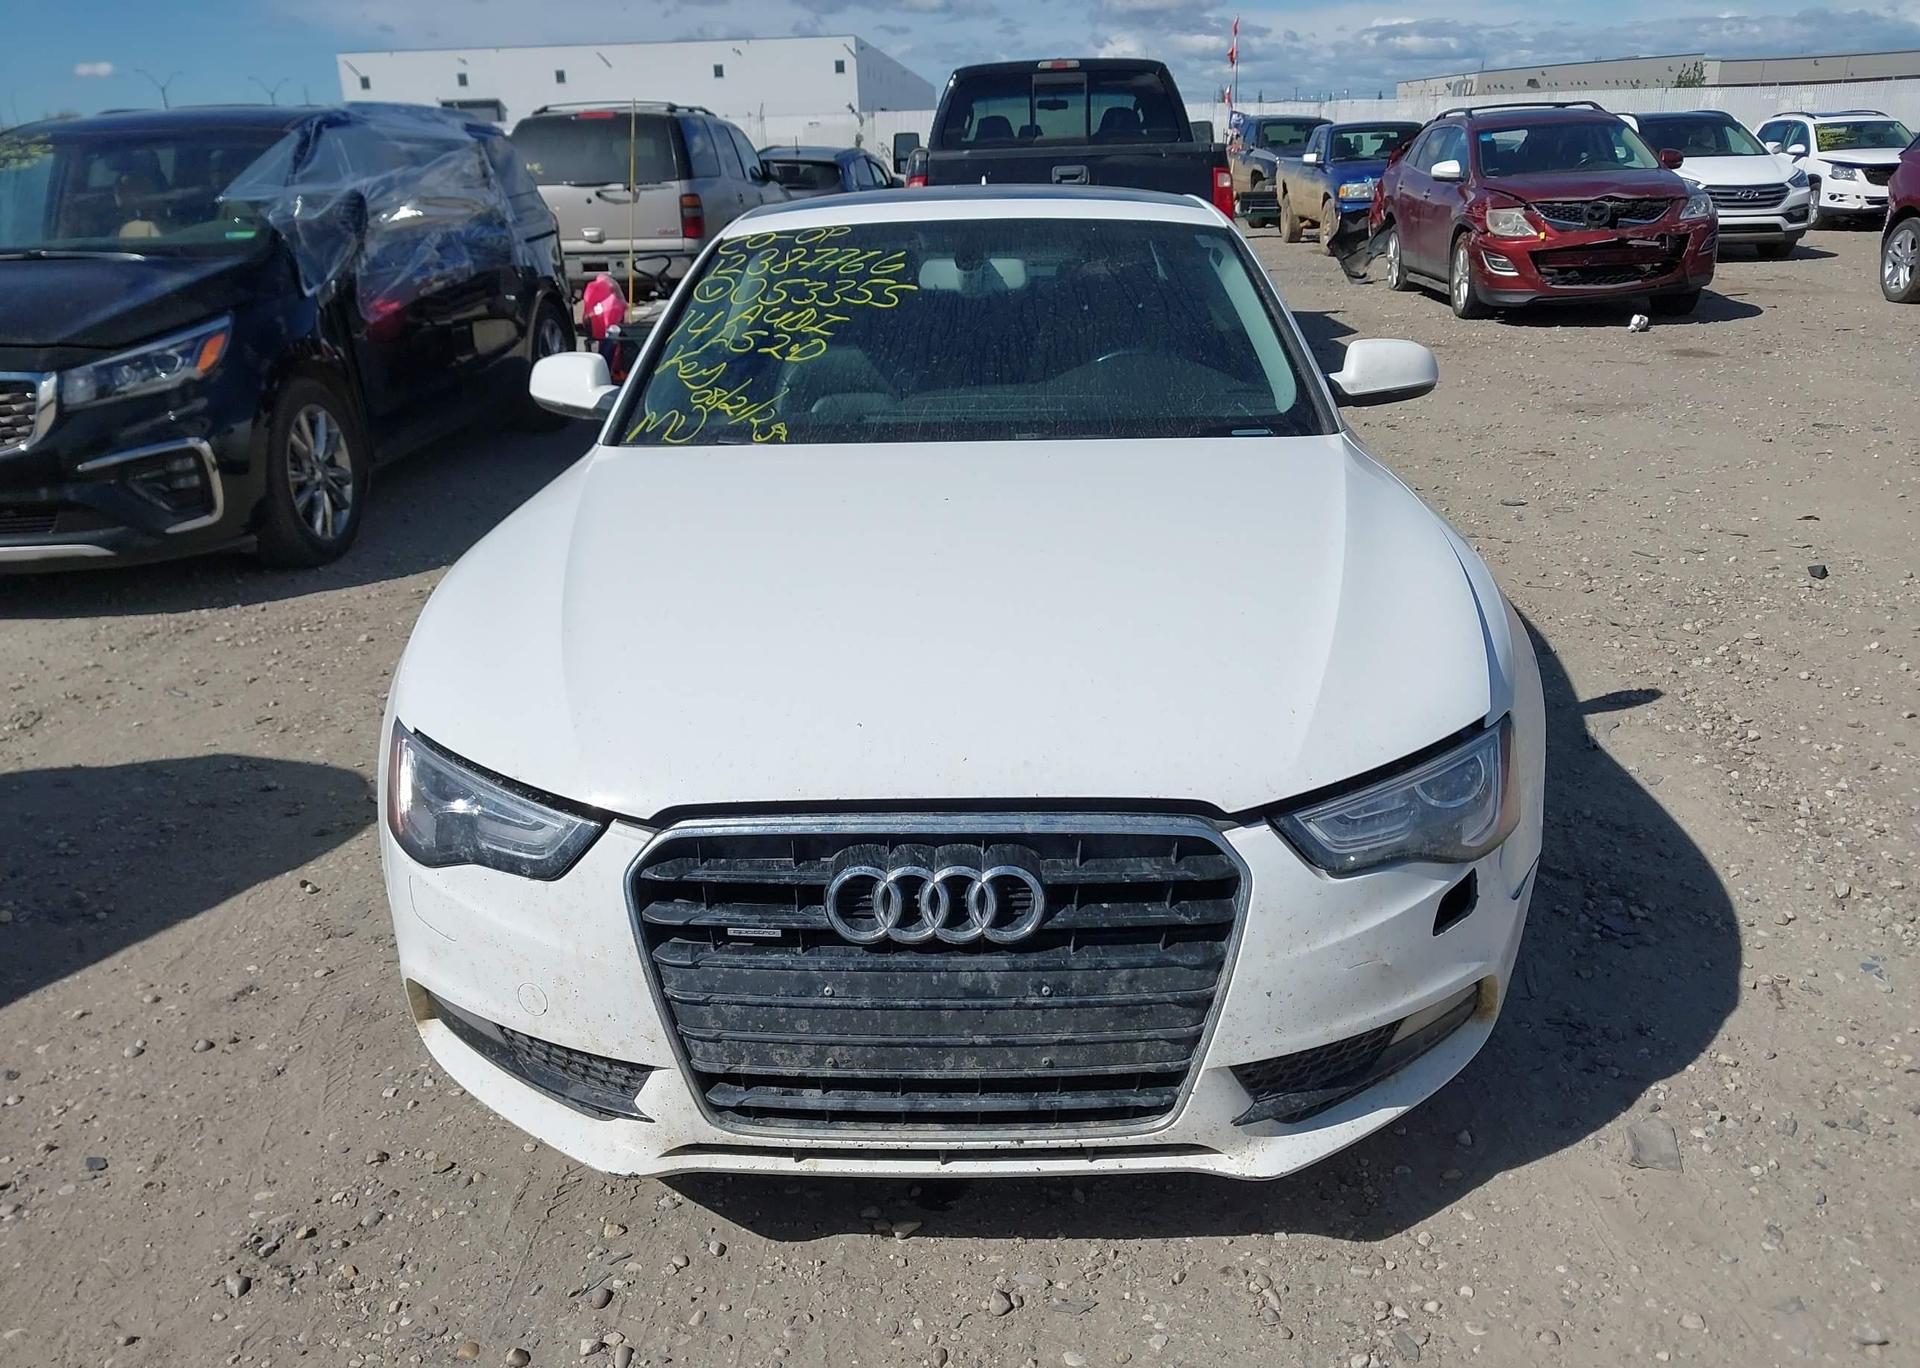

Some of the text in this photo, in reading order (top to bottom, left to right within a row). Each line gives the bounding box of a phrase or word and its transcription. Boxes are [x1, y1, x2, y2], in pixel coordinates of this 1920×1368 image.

[719, 226, 851, 255] CO-OP
[730, 278, 918, 307] 053355
[665, 304, 850, 343] 14 AUDI
